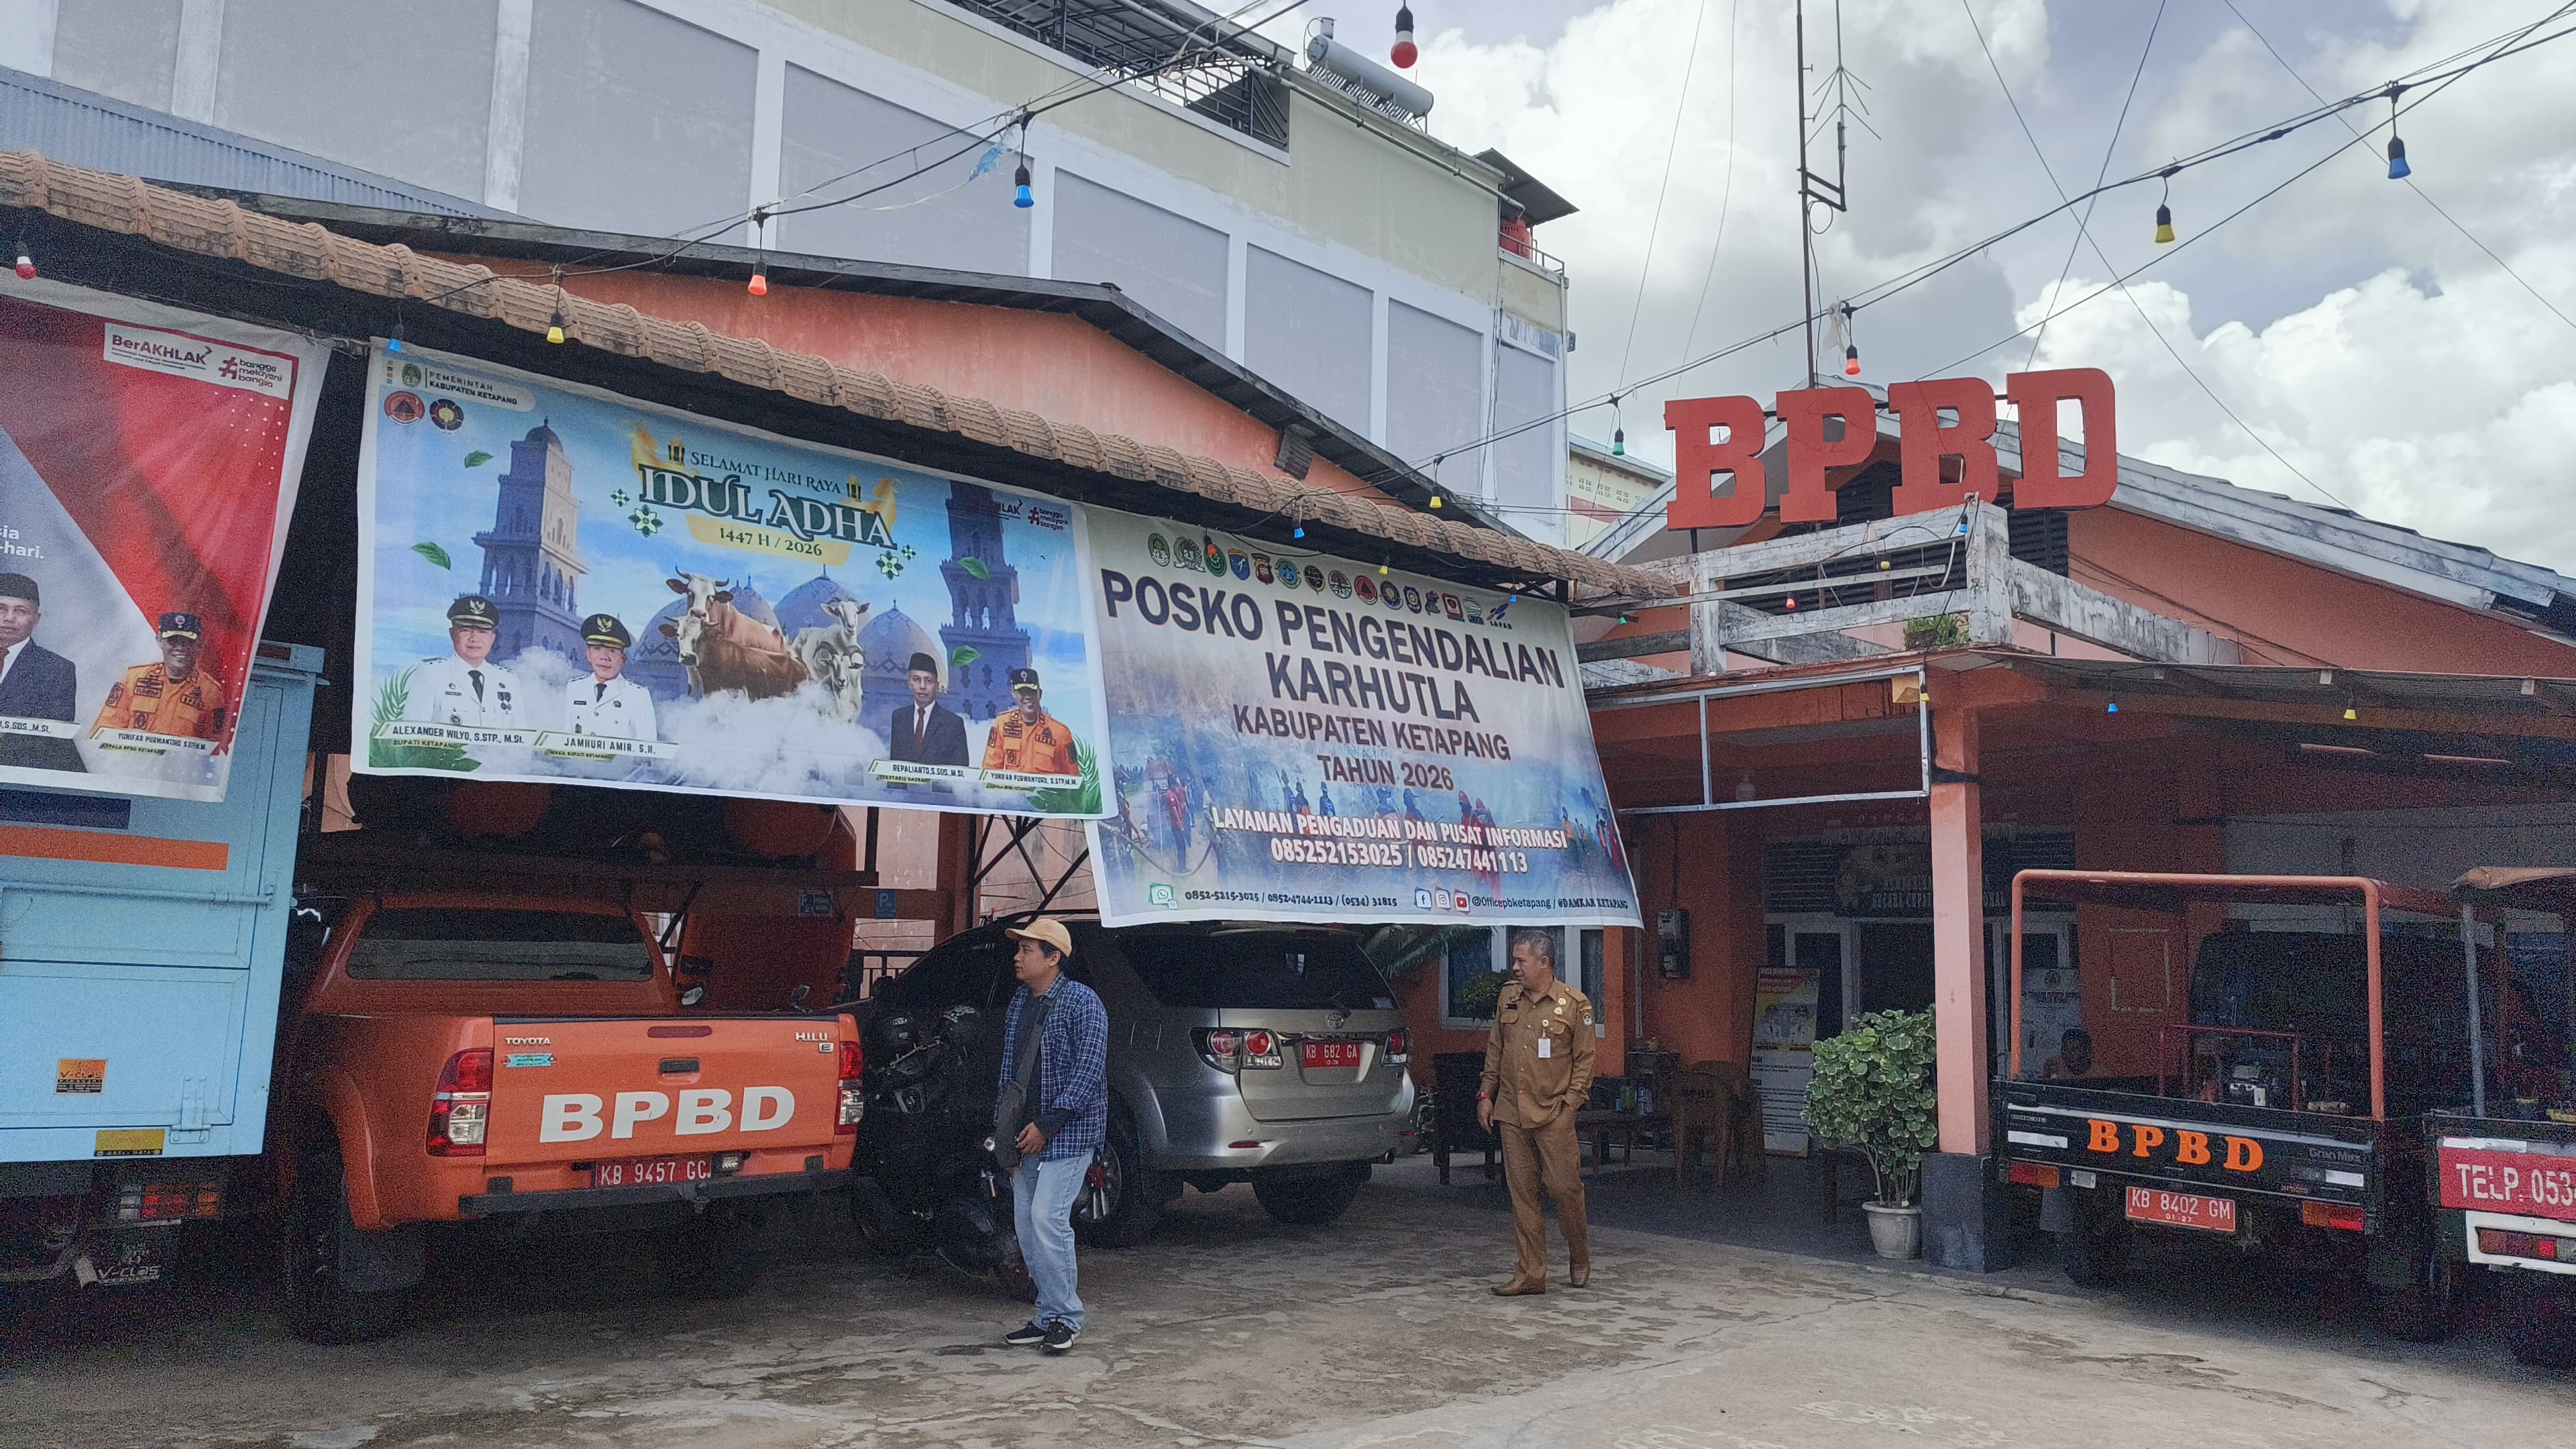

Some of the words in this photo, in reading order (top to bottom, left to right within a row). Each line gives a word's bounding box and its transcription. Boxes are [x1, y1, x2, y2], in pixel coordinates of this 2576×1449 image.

[112, 335, 212, 365] BerAKHLAK
[239, 358, 276, 372] bangga
[429, 372, 493, 391] PEMERINTAH
[429, 381, 476, 396] KABUPATEN
[478, 391, 517, 405] KETAPANG
[1664, 368, 2117, 531] BPBD
[690, 451, 761, 476] SELAMAT
[765, 466, 801, 486] HARI
[806, 476, 841, 494] RAYA
[0, 525, 19, 540] ia
[720, 527, 752, 545] 1447
[758, 533, 769, 547] H
[774, 536, 780, 548] /
[786, 539, 822, 556] 2026
[1101, 568, 1263, 641] POSKO
[1275, 600, 1564, 688] PENGENDALIAN
[1265, 652, 1480, 723] KARHUTLA
[392, 726, 444, 737] ALEXANDER
[564, 737, 605, 750] JAMHURI
[1234, 704, 1387, 747] KABUPATEN
[1391, 721, 1511, 761] KETAPANG
[1318, 755, 1395, 785] TAHUN
[1400, 762, 1454, 790] 2026
[1212, 806, 1294, 834] LAYANAN
[1296, 814, 1401, 840] PENGADUAN
[1404, 820, 1438, 842] DAN
[1440, 822, 1483, 845] PUSAT
[1485, 827, 1568, 849] INFORMASI
[1271, 839, 1403, 867] 085252153025
[1417, 846, 1528, 873] 085247441113
[1185, 890, 1259, 902] 0852-5215-3025
[1342, 894, 1368, 906] (0534)
[505, 1036, 551, 1046] TOYOTA
[1306, 1044, 1316, 1059] KB
[1324, 1044, 1340, 1058] 682
[1347, 1044, 1358, 1058] GA
[539, 1085, 795, 1143] BPBD
[2087, 1120, 2264, 1173] BPBD
[601, 1165, 623, 1185] KB
[635, 1162, 676, 1183] 9457
[686, 1160, 706, 1181] GC
[2456, 1163, 2520, 1201] TELP
[2132, 1189, 2150, 1208] KB
[2160, 1193, 2199, 1216] 8402
[2209, 1200, 2231, 1220] GM
